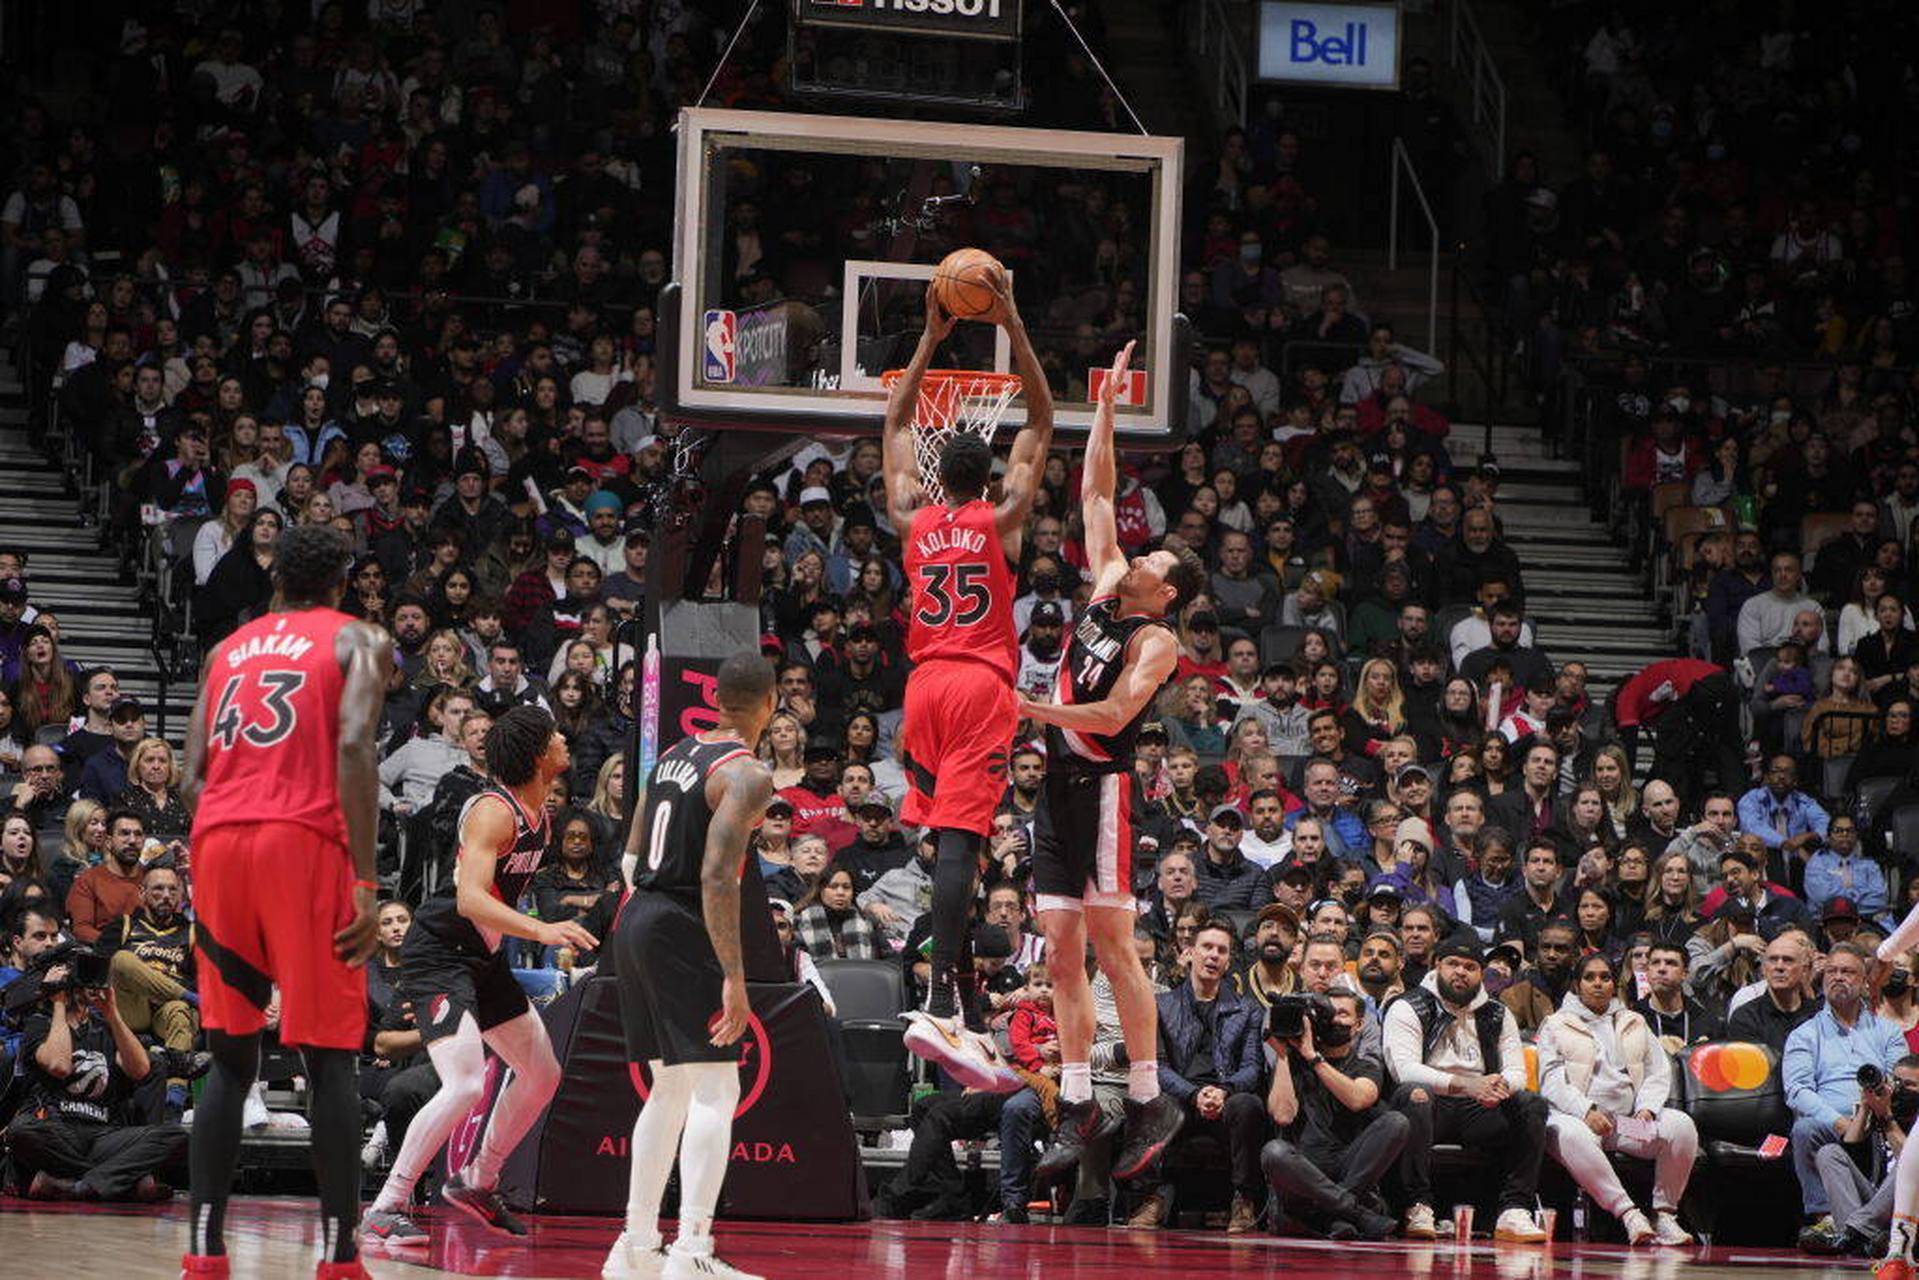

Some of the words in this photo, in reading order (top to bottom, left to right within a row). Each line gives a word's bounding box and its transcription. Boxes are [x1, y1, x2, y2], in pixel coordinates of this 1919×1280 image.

[1290, 19, 1367, 66] Bell
[736, 321, 787, 365] KPOTCITY
[916, 527, 986, 558] KOLOKO
[917, 564, 992, 627] 35
[228, 634, 314, 668] SIAKAM
[1077, 655, 1105, 692] 24
[208, 670, 306, 750] 43
[798, 806, 847, 820] RAPTOR
[648, 800, 671, 871] 0
[133, 940, 185, 963] Toronto
[597, 1136, 627, 1157] AI
[729, 1141, 796, 1163] ADA
